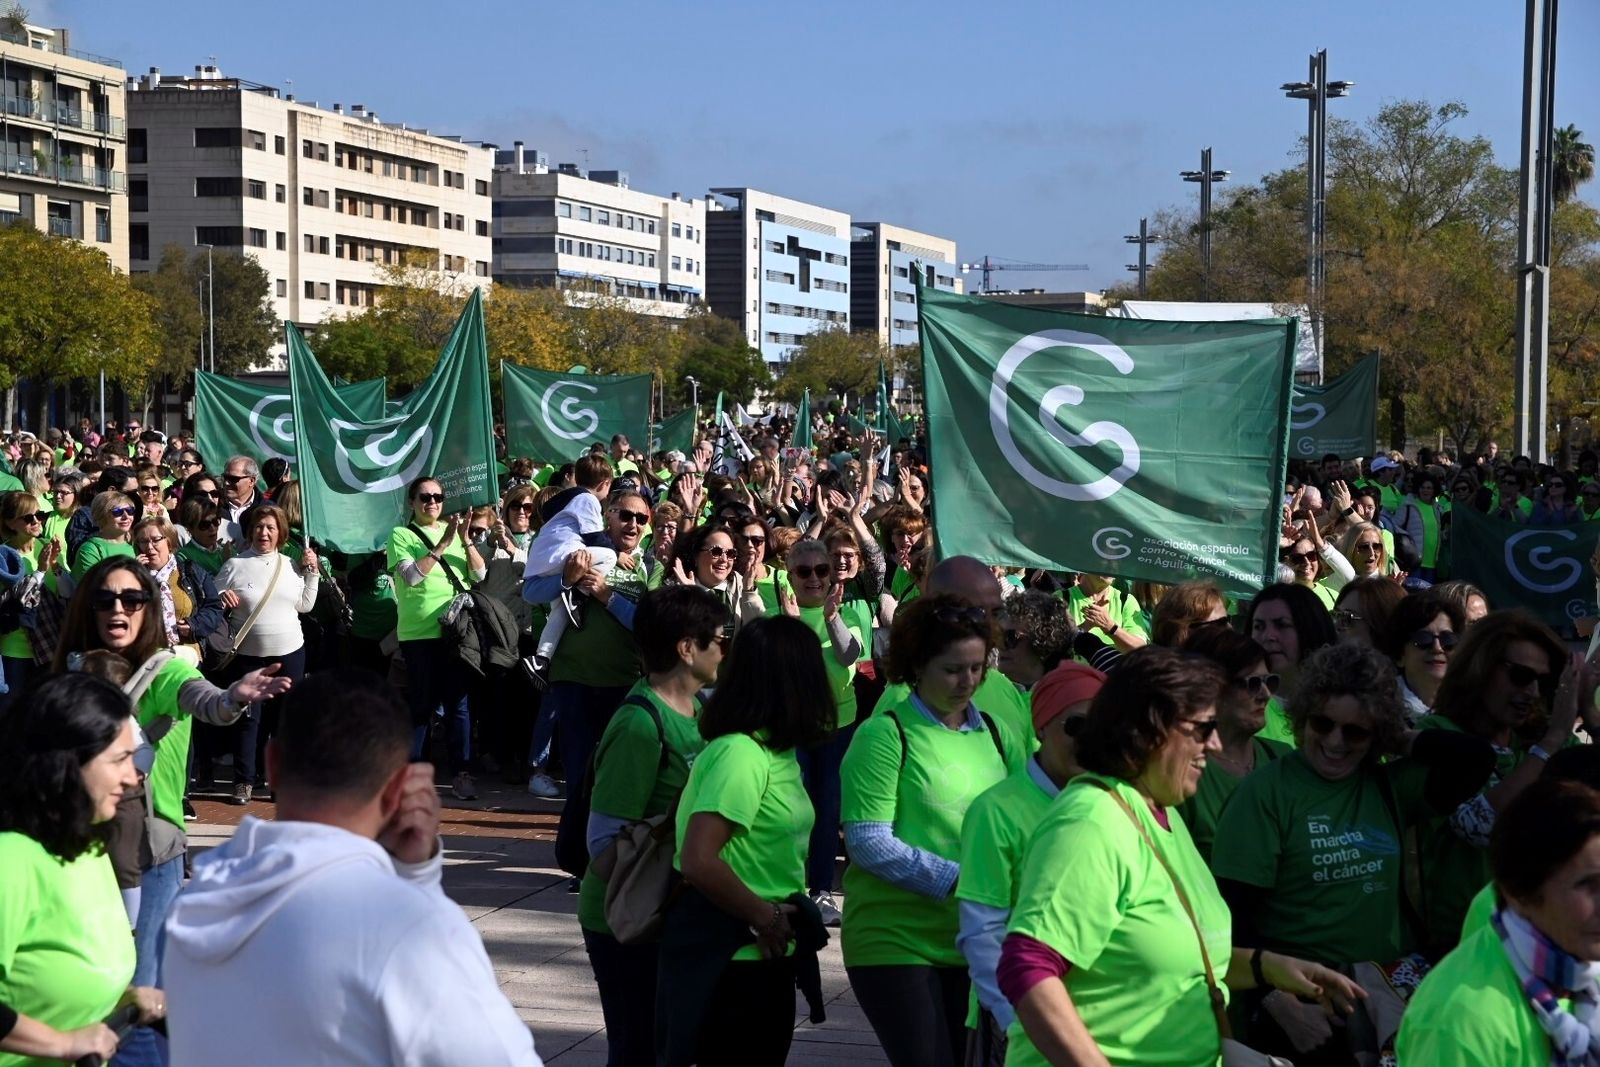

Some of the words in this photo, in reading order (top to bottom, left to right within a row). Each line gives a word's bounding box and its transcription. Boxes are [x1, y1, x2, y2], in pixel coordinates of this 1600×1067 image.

[434, 464, 471, 480] ociación
[471, 462, 487, 472] espa
[1143, 536, 1199, 551] asociación
[1201, 543, 1249, 555] española
[1140, 546, 1177, 557] contra
[1180, 552, 1189, 561] el
[1192, 554, 1227, 566] cáncer
[1137, 555, 1152, 564] en
[1153, 556, 1195, 570] Aguilar
[1197, 565, 1212, 573] de
[1215, 569, 1225, 577] la
[608, 569, 638, 582] aecc
[1307, 822, 1330, 834] En
[1310, 831, 1364, 849] marcha
[1312, 848, 1361, 866] contra
[1312, 867, 1330, 882] el
[1332, 859, 1384, 880] cáncer
